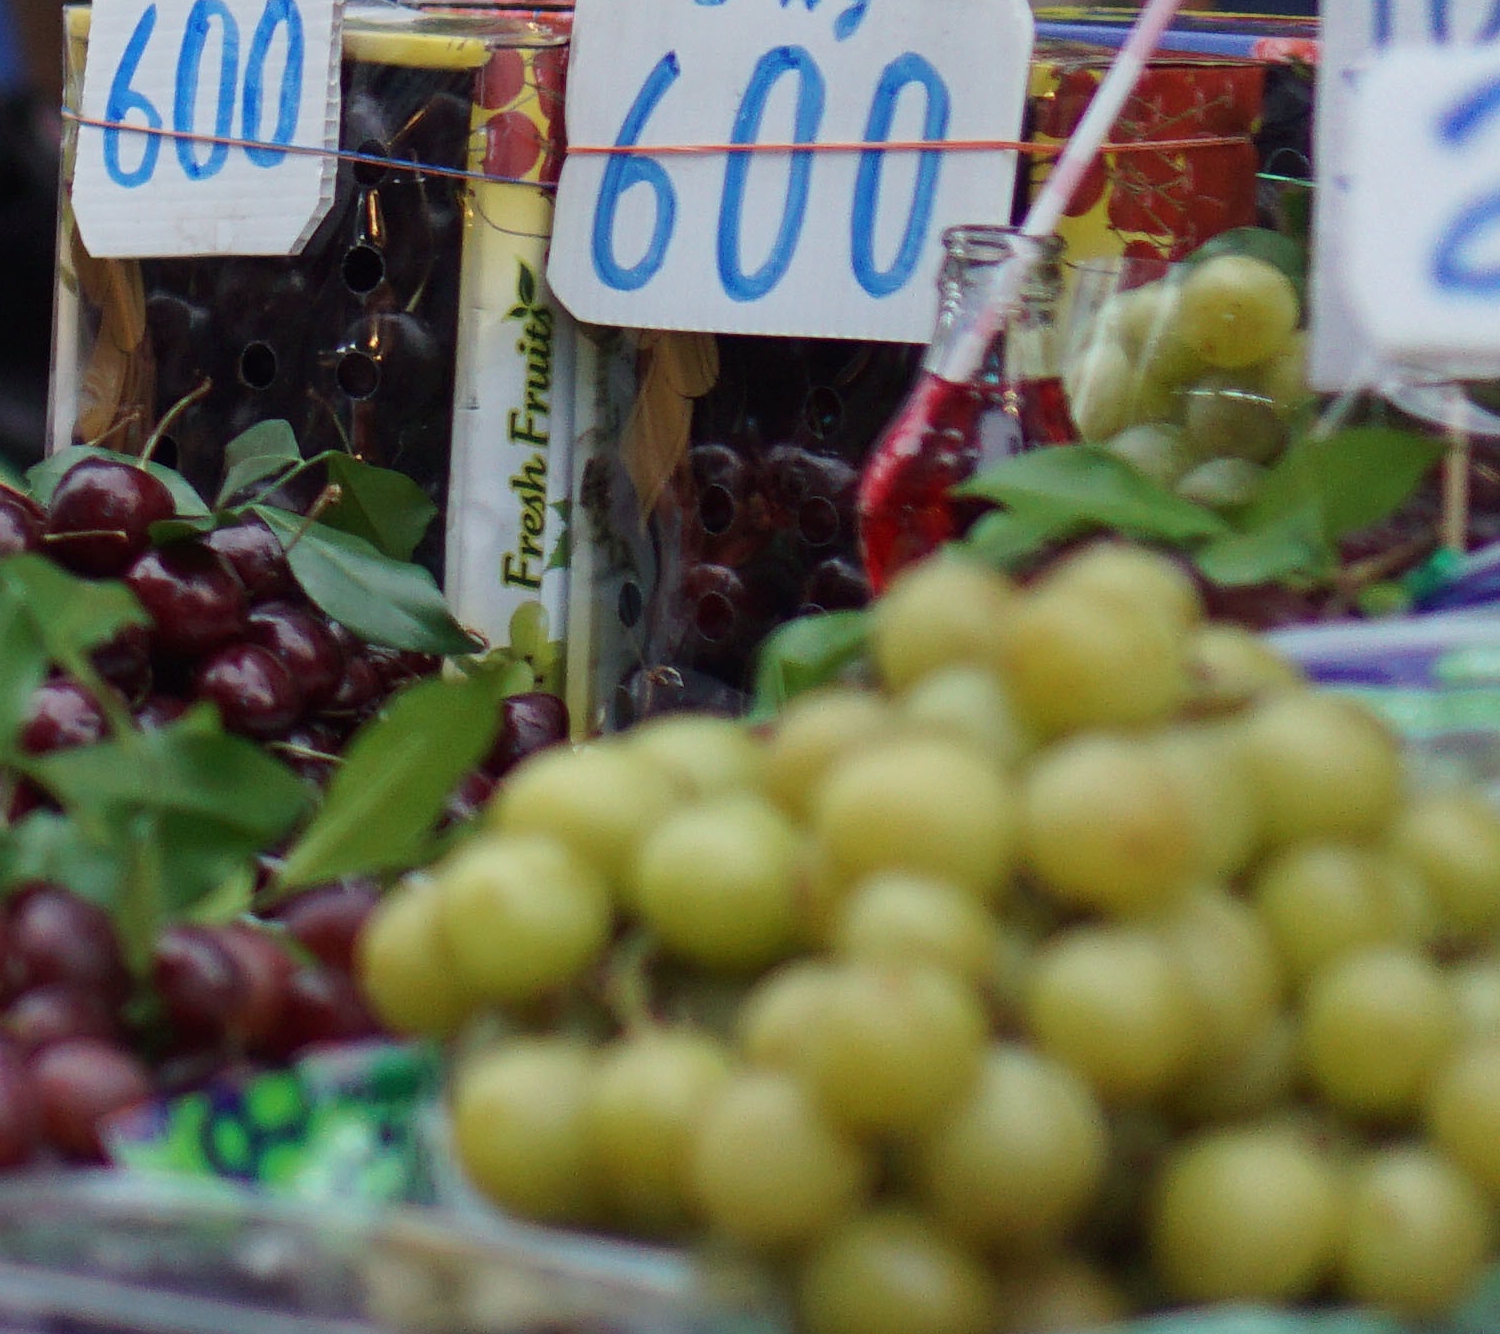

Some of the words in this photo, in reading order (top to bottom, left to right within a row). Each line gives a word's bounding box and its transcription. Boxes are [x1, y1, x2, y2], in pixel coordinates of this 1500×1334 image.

[589, 44, 951, 303] 600
[507, 303, 555, 449] Fruits
[501, 451, 548, 591] Fresh
